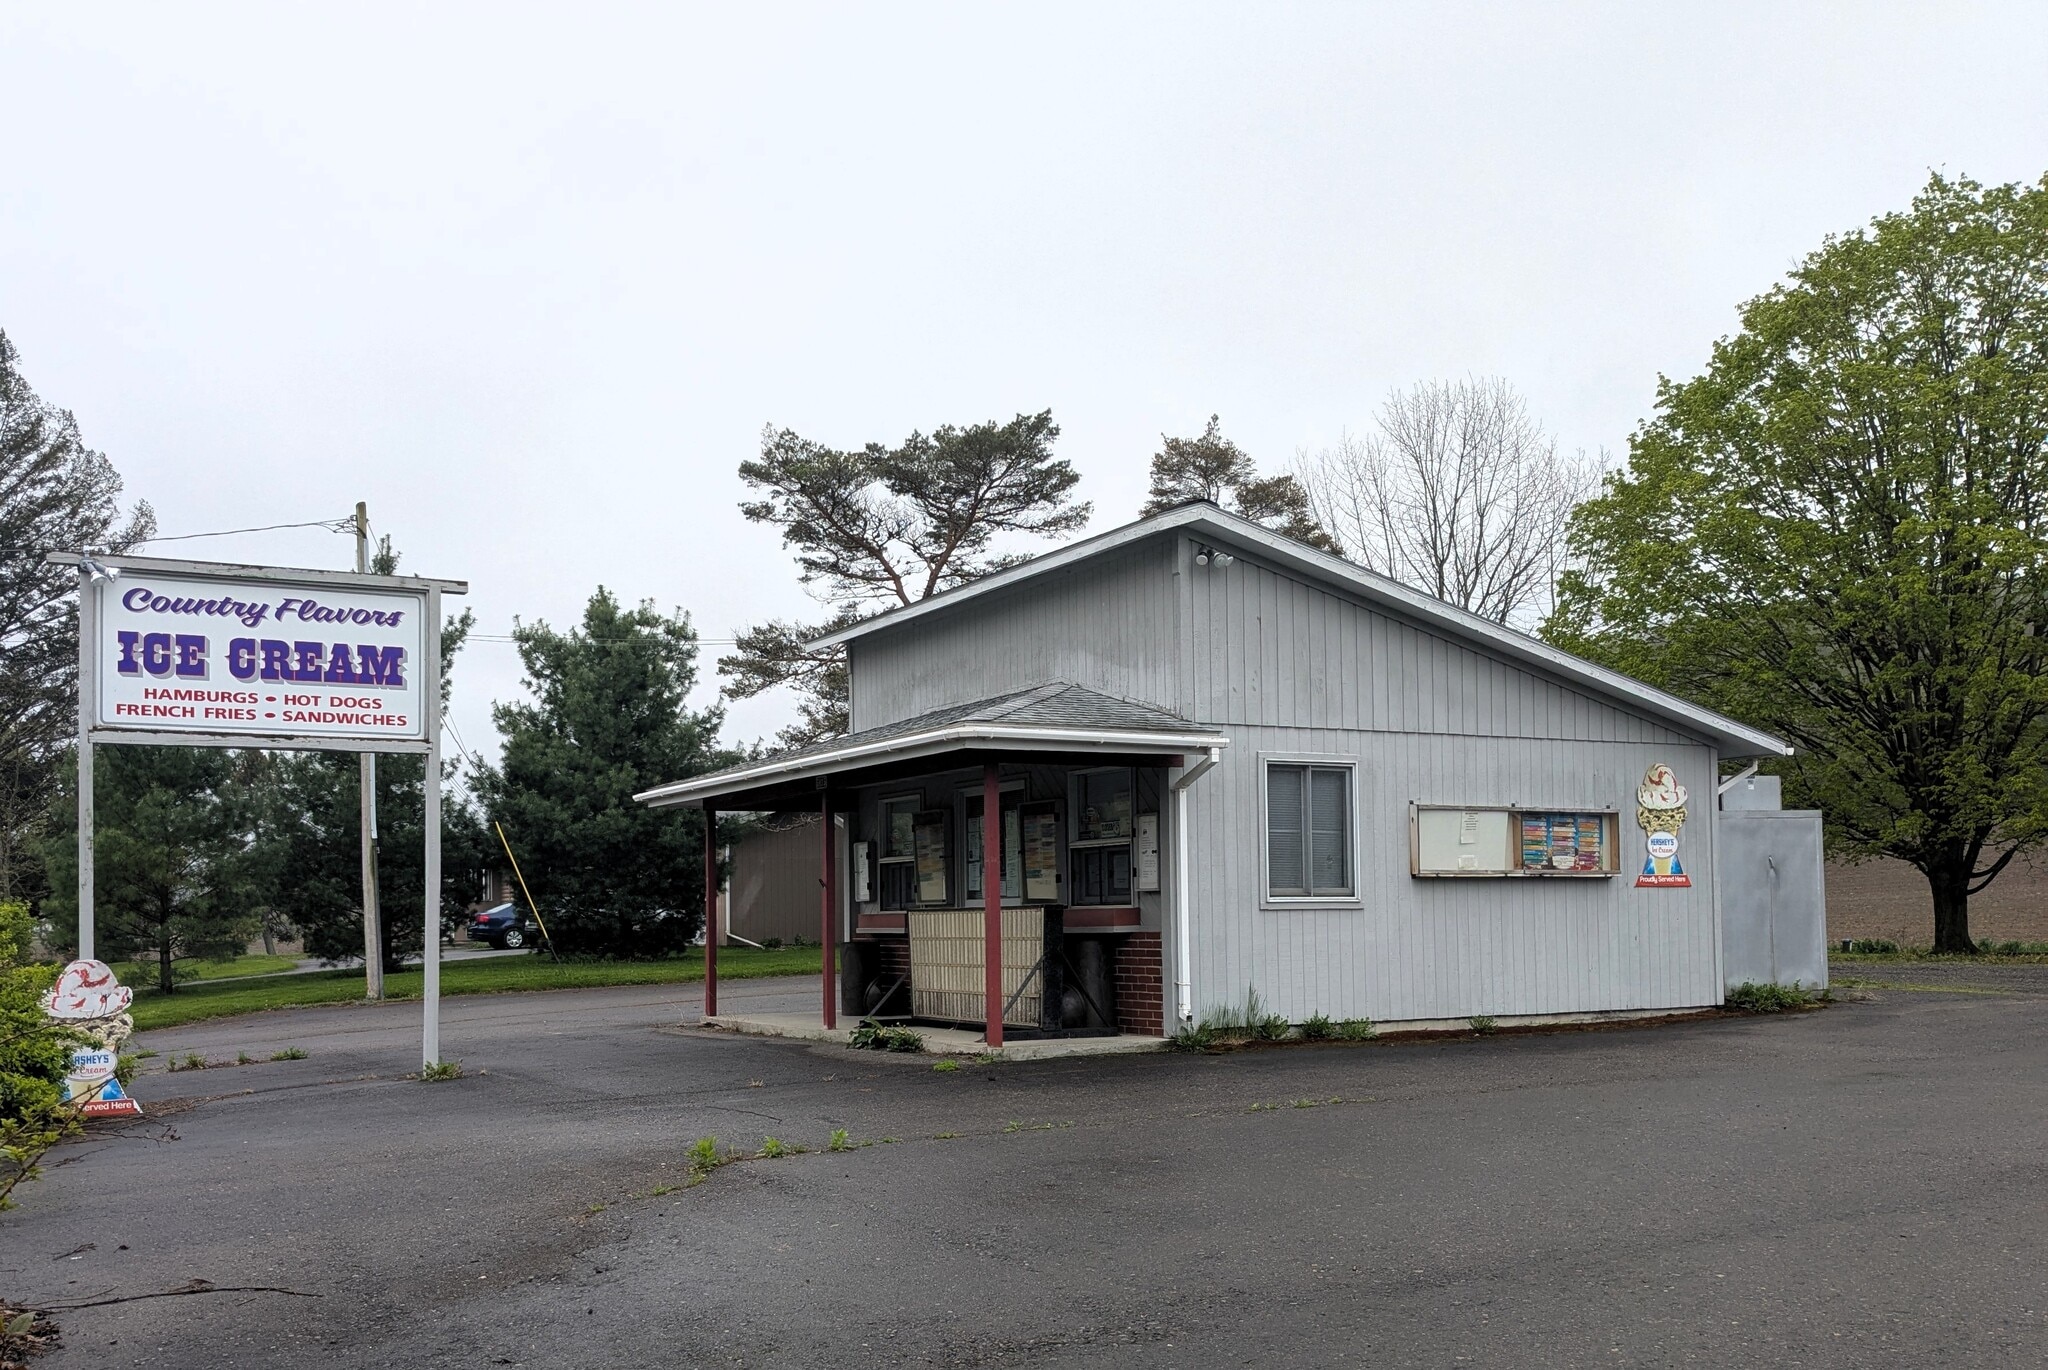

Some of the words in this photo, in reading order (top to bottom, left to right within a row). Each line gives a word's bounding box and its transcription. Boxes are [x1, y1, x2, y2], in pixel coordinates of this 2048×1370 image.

[122, 587, 270, 628] Country
[275, 598, 405, 628] Flavors
[118, 630, 208, 679] ICE
[226, 637, 406, 688] CREAM
[144, 688, 258, 704] HAMBURGS
[284, 694, 322, 707] HOT
[330, 696, 382, 710] DOGS
[116, 703, 195, 718] FRENCH
[204, 707, 257, 721] FRIES
[282, 710, 407, 727] SANDWICHES
[1650, 838, 1674, 846] HERSHEY'S
[74, 1054, 109, 1065] RSHEY'S
[111, 1101, 132, 1110] Here
